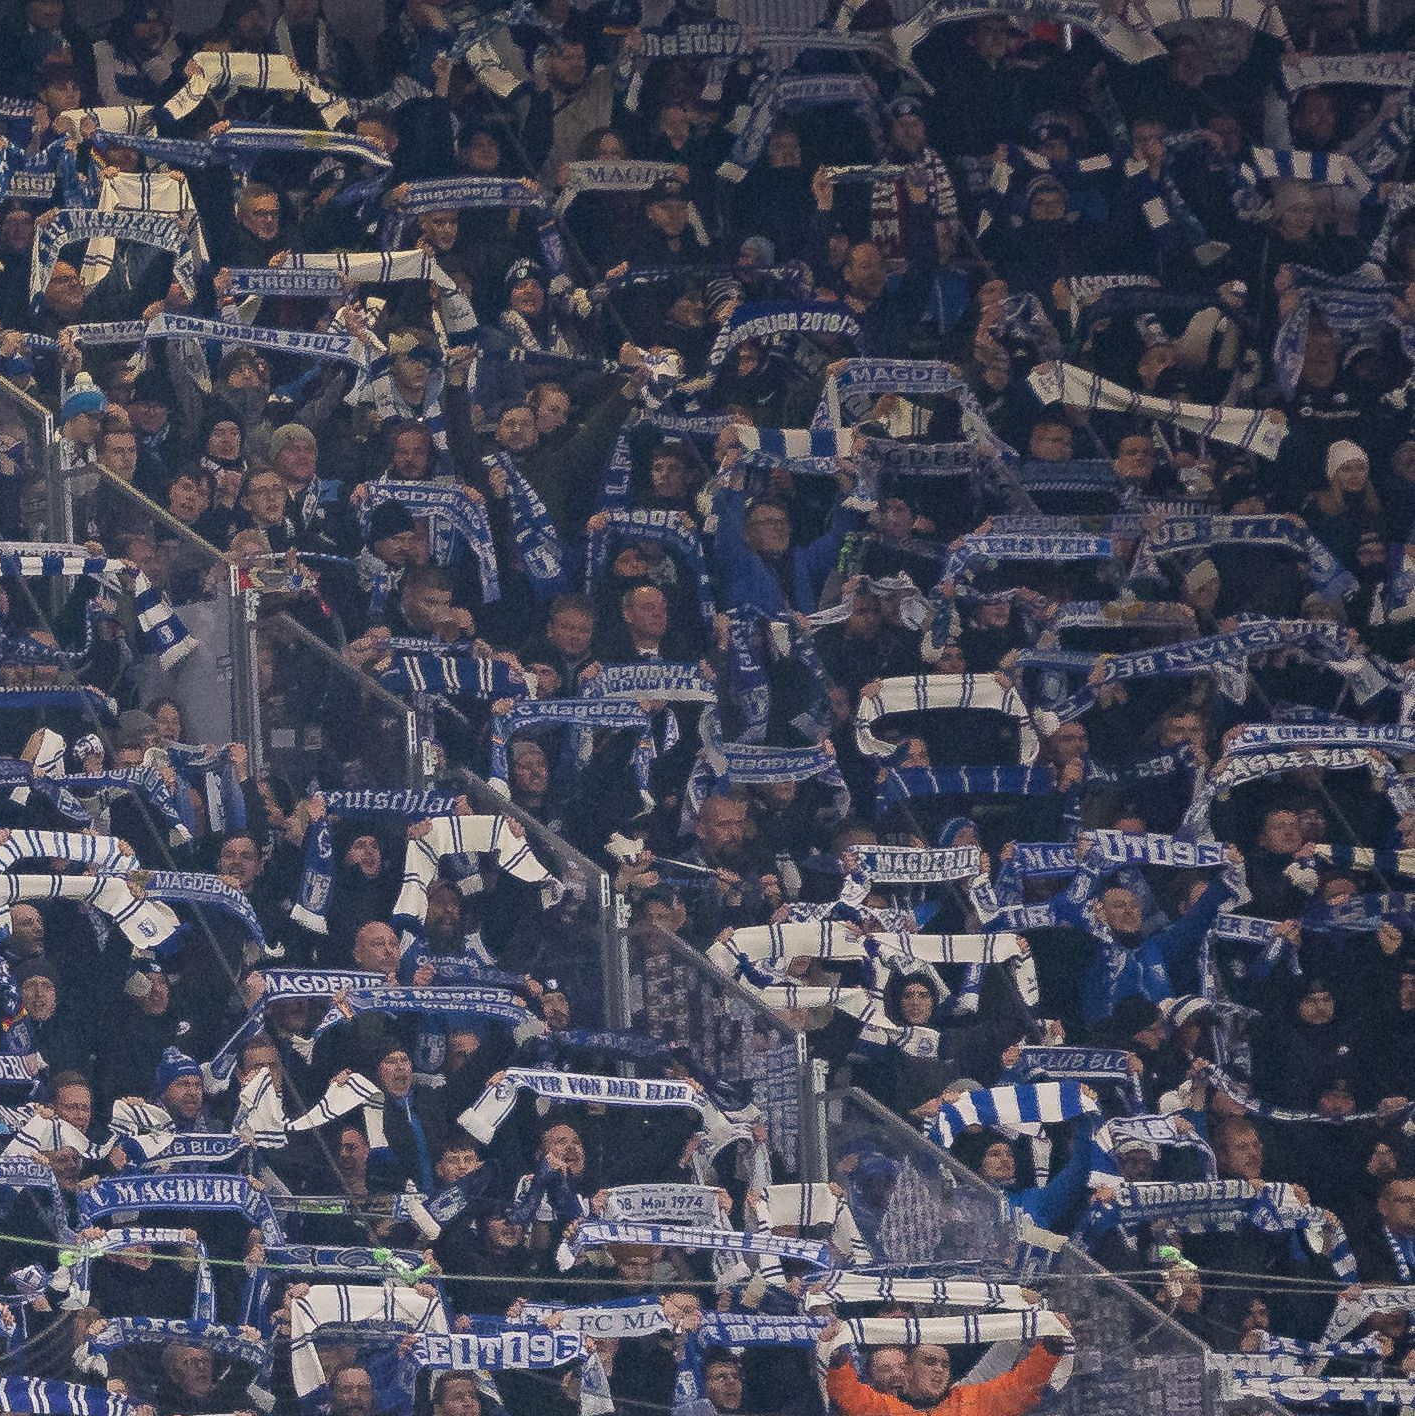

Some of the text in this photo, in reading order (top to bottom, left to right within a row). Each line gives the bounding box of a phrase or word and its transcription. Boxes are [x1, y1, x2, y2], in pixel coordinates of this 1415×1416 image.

[567, 1077, 600, 1097] VON
[604, 1079, 637, 1099] DER
[579, 1311, 665, 1332] FC MA
